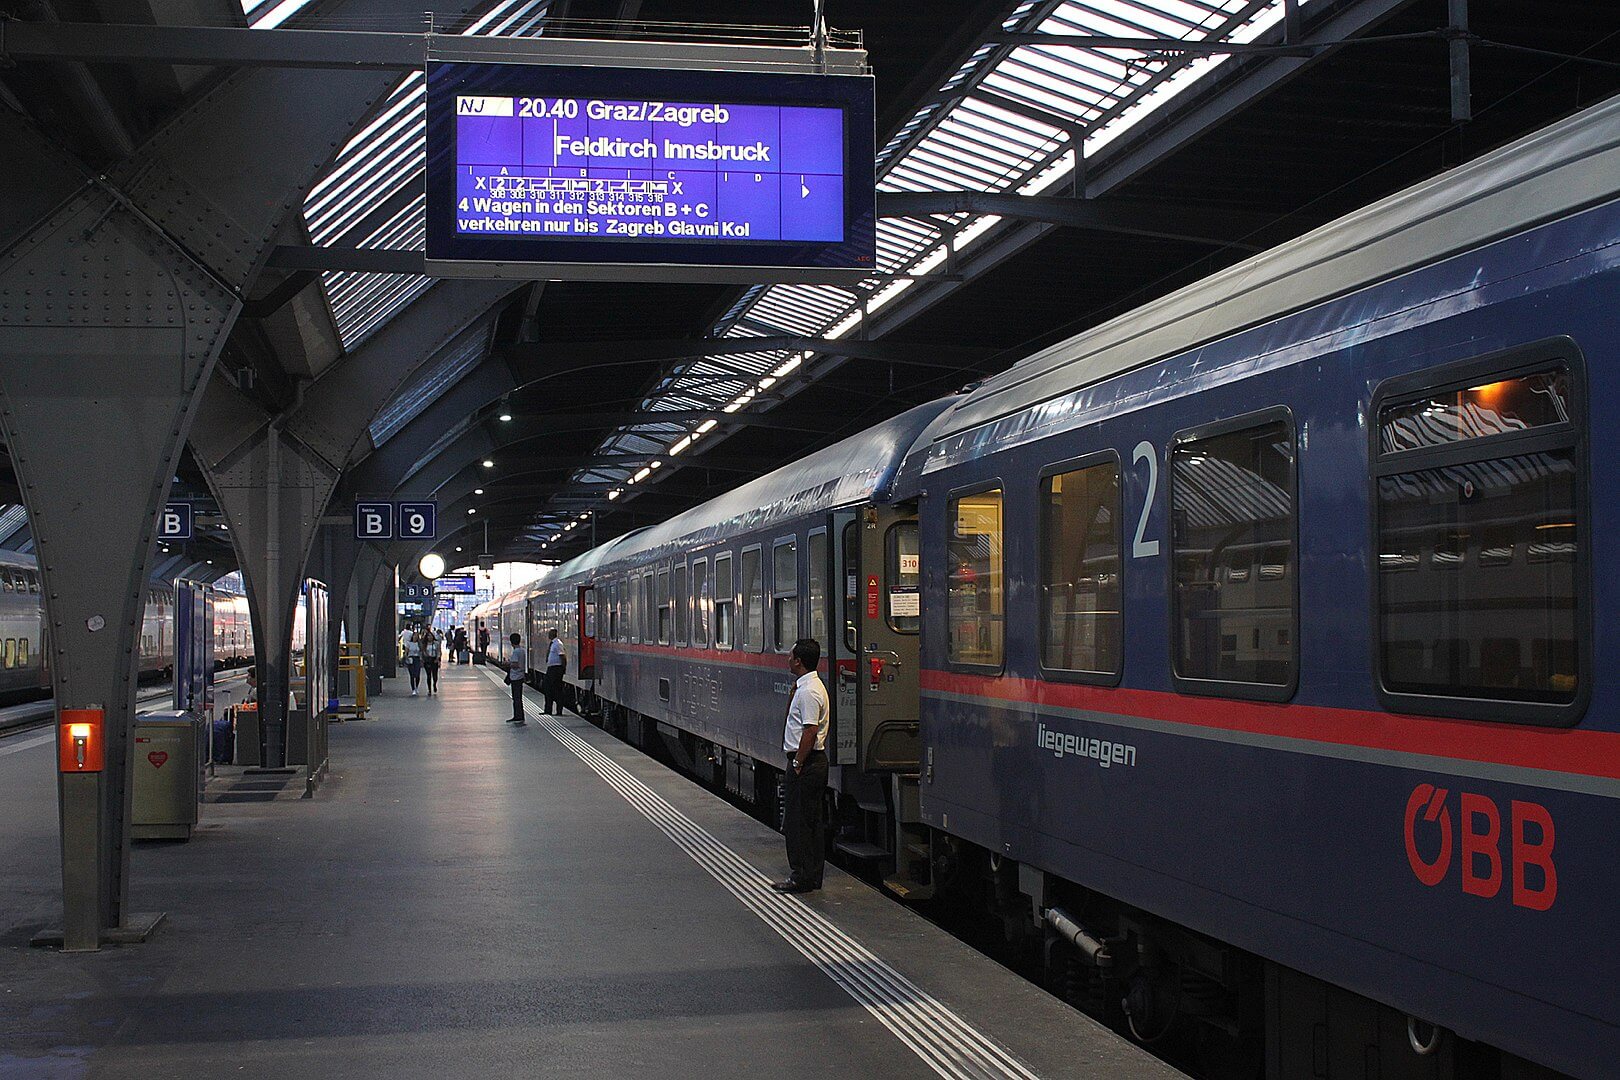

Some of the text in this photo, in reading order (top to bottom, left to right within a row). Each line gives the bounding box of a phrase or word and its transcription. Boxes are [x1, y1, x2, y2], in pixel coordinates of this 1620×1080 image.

[460, 97, 730, 127] NJ 20.40 Graz/Zagreb
[556, 135, 771, 162] Feldkirch Innsbruck
[500, 166, 762, 182] A B C D
[474, 176, 684, 195] X 2 2 2 X
[458, 197, 709, 218] 4 Wagen in den Sektoren B + C
[530, 191, 546, 200] 310
[549, 191, 565, 200] 311
[569, 192, 585, 201] 312
[589, 192, 605, 202] 313
[608, 193, 625, 202] 314
[628, 193, 644, 203] 315
[458, 216, 750, 237] verkehren nur bis Zagreb Glavni Kol
[1132, 440, 1160, 559] 2
[164, 513, 181, 534] B
[366, 513, 383, 534] B
[409, 513, 425, 534] 9
[902, 559, 917, 568] 310
[408, 588, 415, 596] B
[422, 588, 429, 596] 9
[1037, 723, 1137, 768] liegewagen
[1403, 782, 1558, 912] ÖBB
